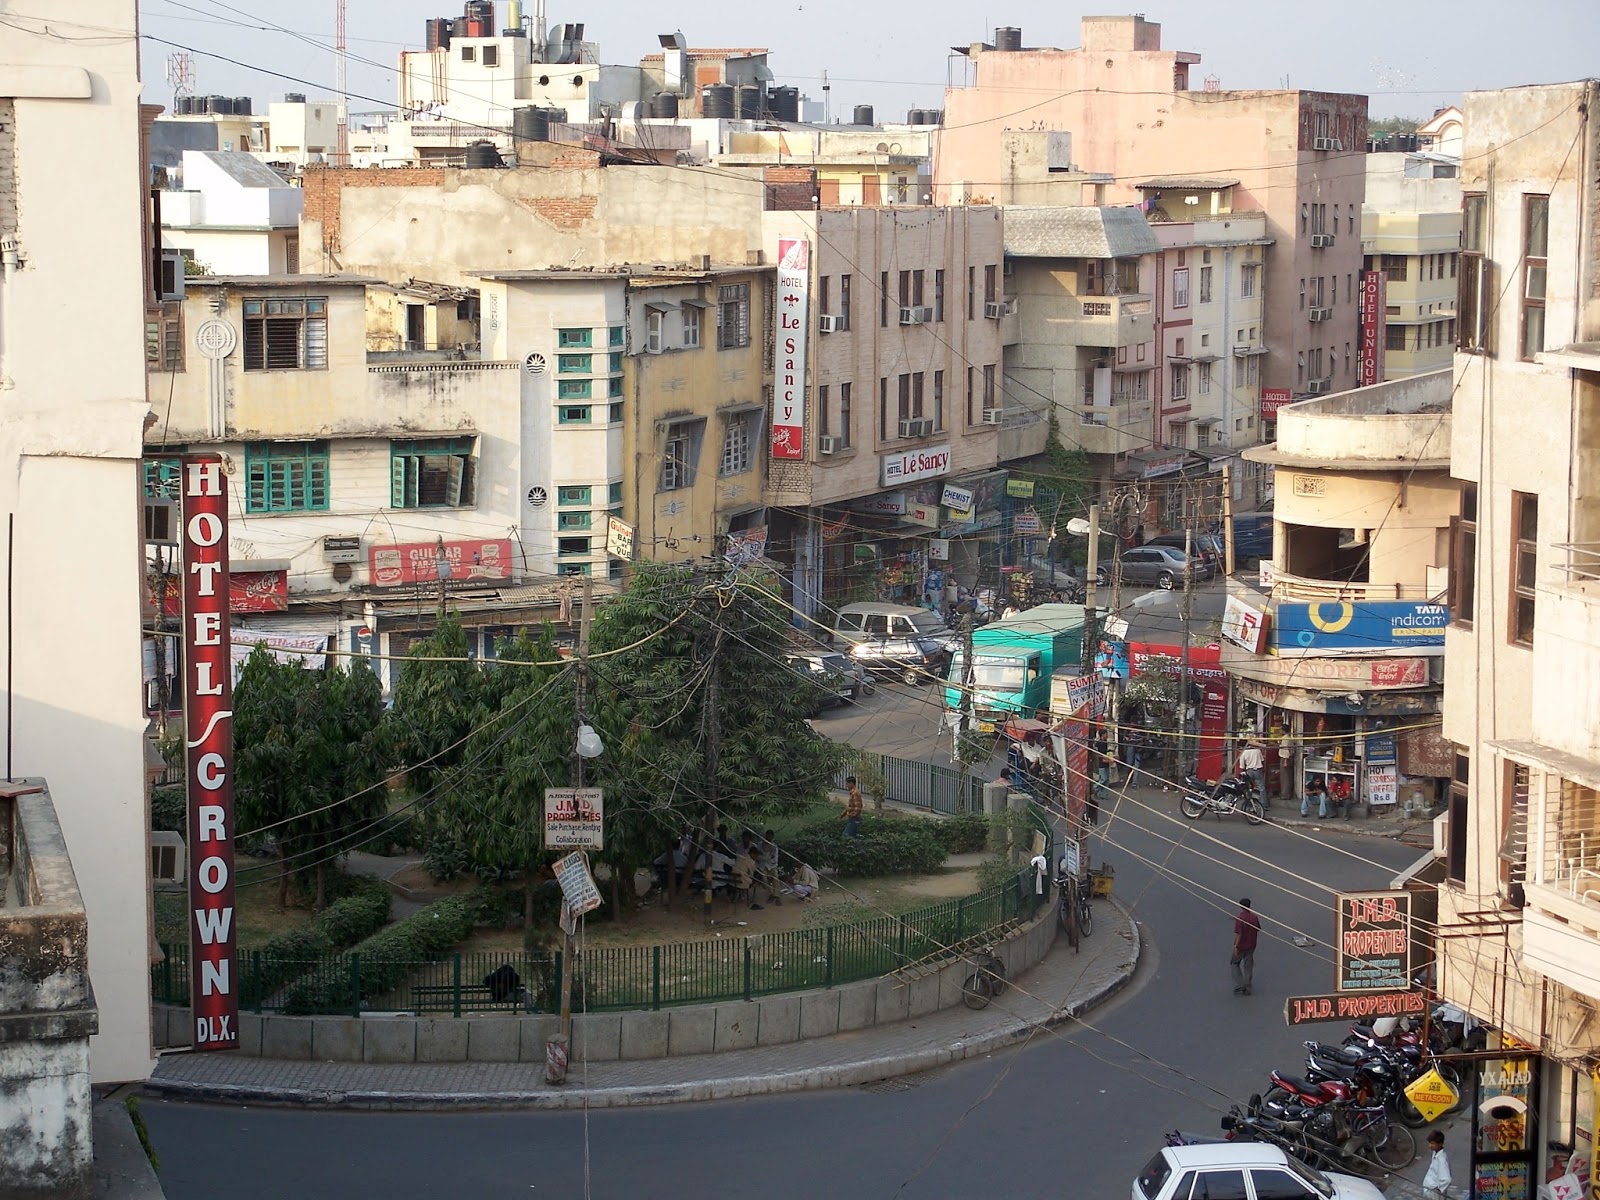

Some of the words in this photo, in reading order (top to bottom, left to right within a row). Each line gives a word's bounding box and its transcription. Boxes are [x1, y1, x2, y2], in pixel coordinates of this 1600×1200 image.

[780, 277, 804, 288] HOTEL
[1367, 274, 1377, 323] HOTEL
[781, 312, 800, 330] Le
[783, 337, 796, 421] Sancy
[1265, 392, 1288, 401] HOTEL
[886, 464, 902, 475] HOTEL
[918, 451, 949, 472] Sancy
[943, 489, 971, 504] CHEMIST
[876, 501, 900, 512] Sancy
[409, 546, 462, 561] GULAR
[186, 462, 224, 696] HOTEL
[1415, 605, 1445, 614] TATA
[1391, 613, 1446, 626] indicom
[1369, 766, 1385, 775] HOT
[547, 811, 601, 822] PROPEIES
[547, 823, 558, 831] Sale
[555, 835, 592, 844] Collaboration
[195, 752, 233, 996] CROWN
[1350, 897, 1401, 929] J.M.D.
[1343, 928, 1407, 957] PROPERTIES
[1293, 999, 1335, 1023] J.M.D.
[1338, 992, 1424, 1018] PROPERTIES
[197, 1015, 236, 1043] DLX.
